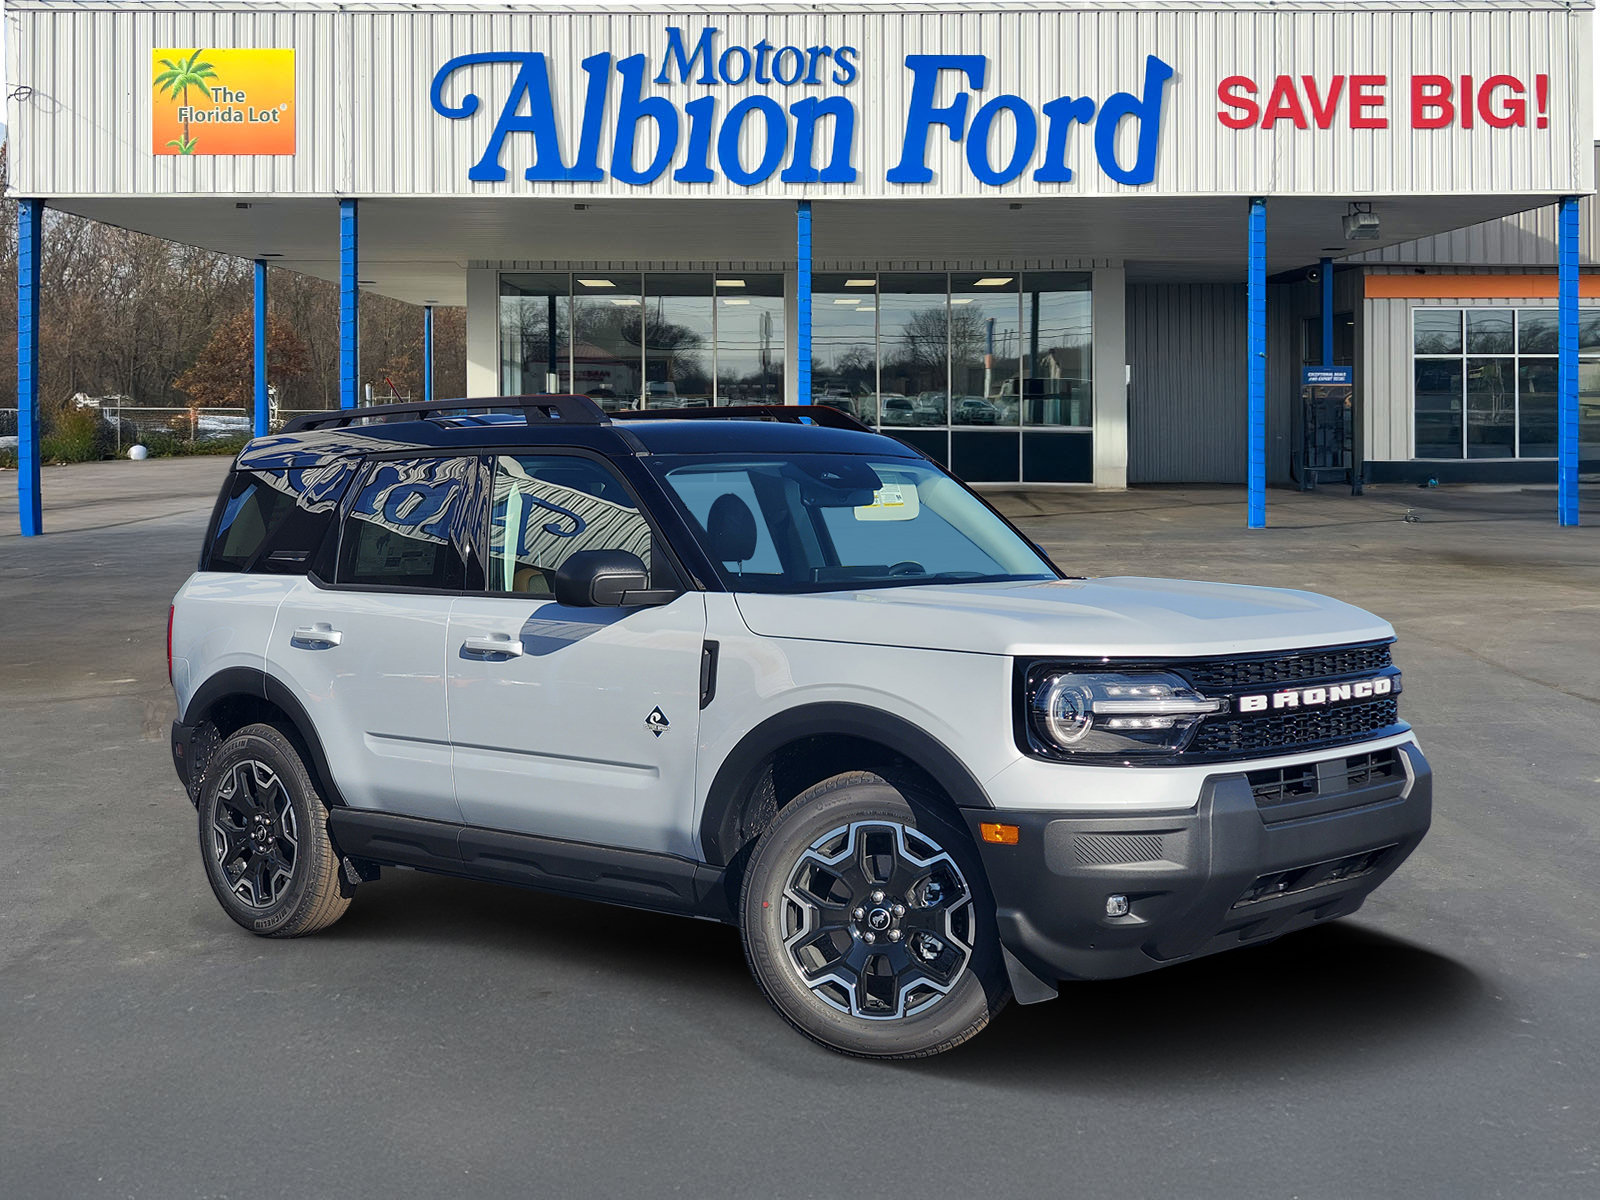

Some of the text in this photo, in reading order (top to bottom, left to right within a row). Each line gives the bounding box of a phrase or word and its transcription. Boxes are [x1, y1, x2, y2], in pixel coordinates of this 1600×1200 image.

[653, 27, 858, 86] Motors
[178, 107, 243, 122] Florida
[211, 87, 246, 103] The
[1217, 74, 1548, 129] SAVE BIG!
[430, 51, 1174, 186] Albion Ford
[1239, 678, 1392, 713] BRONCO
